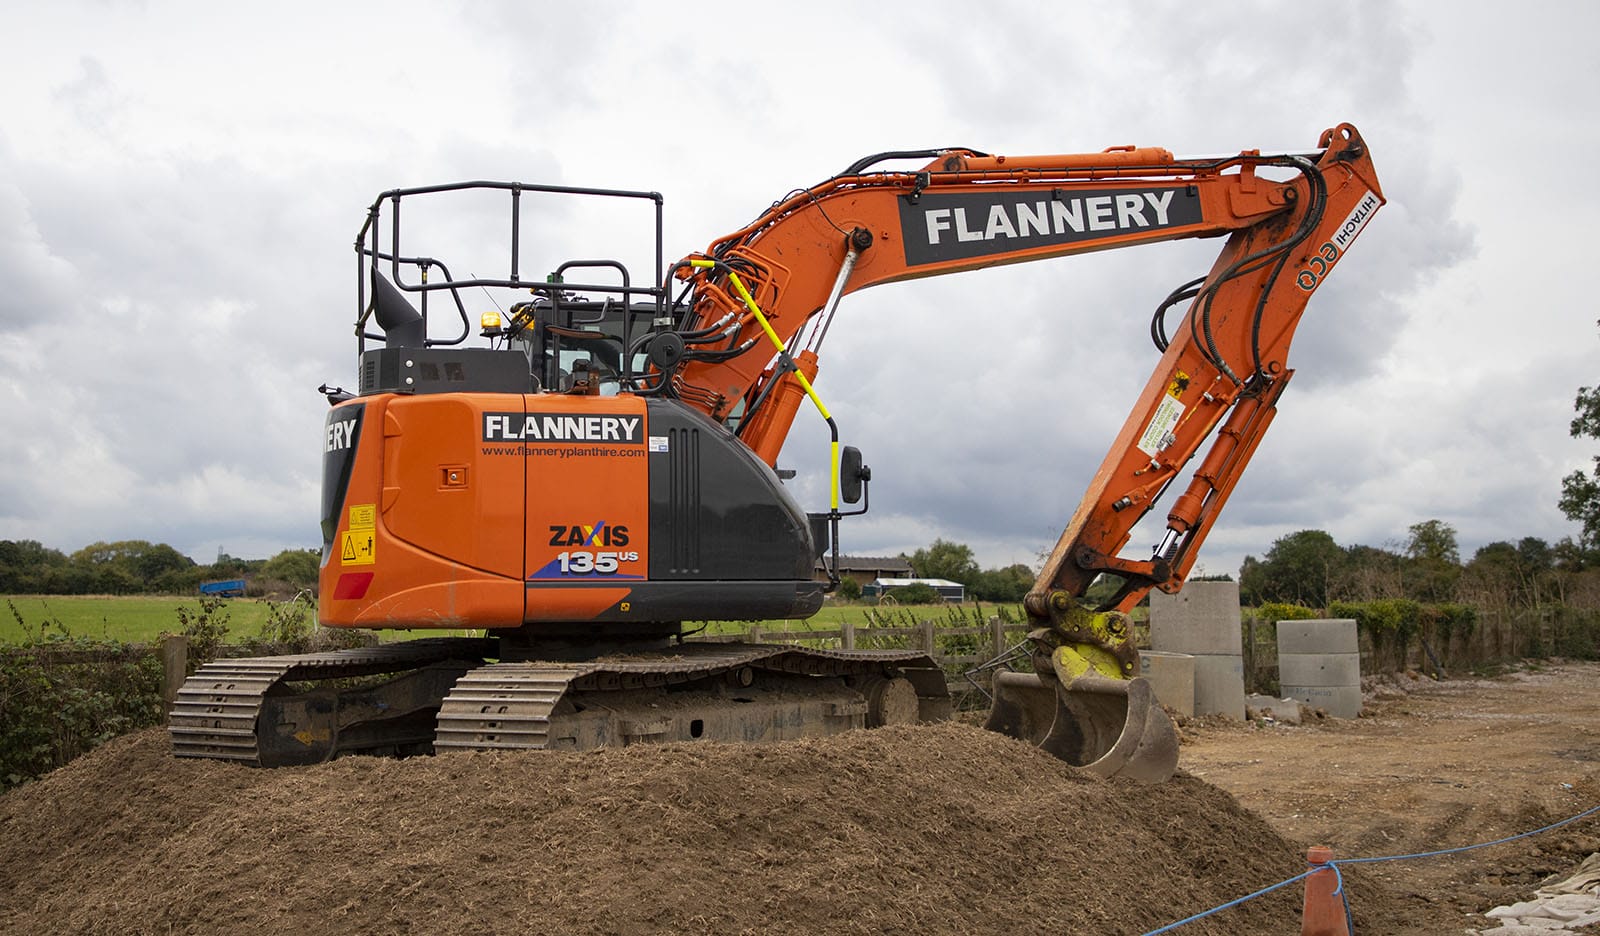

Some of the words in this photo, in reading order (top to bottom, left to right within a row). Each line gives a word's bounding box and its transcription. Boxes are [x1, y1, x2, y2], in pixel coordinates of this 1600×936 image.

[925, 190, 1175, 245] FLANNERY
[1336, 196, 1376, 246] HITACHI
[1297, 242, 1339, 291] eco
[486, 416, 639, 441] FLANNERY
[482, 446, 644, 459] www.flanneryplanthire.com
[549, 520, 629, 547] ZAXIS
